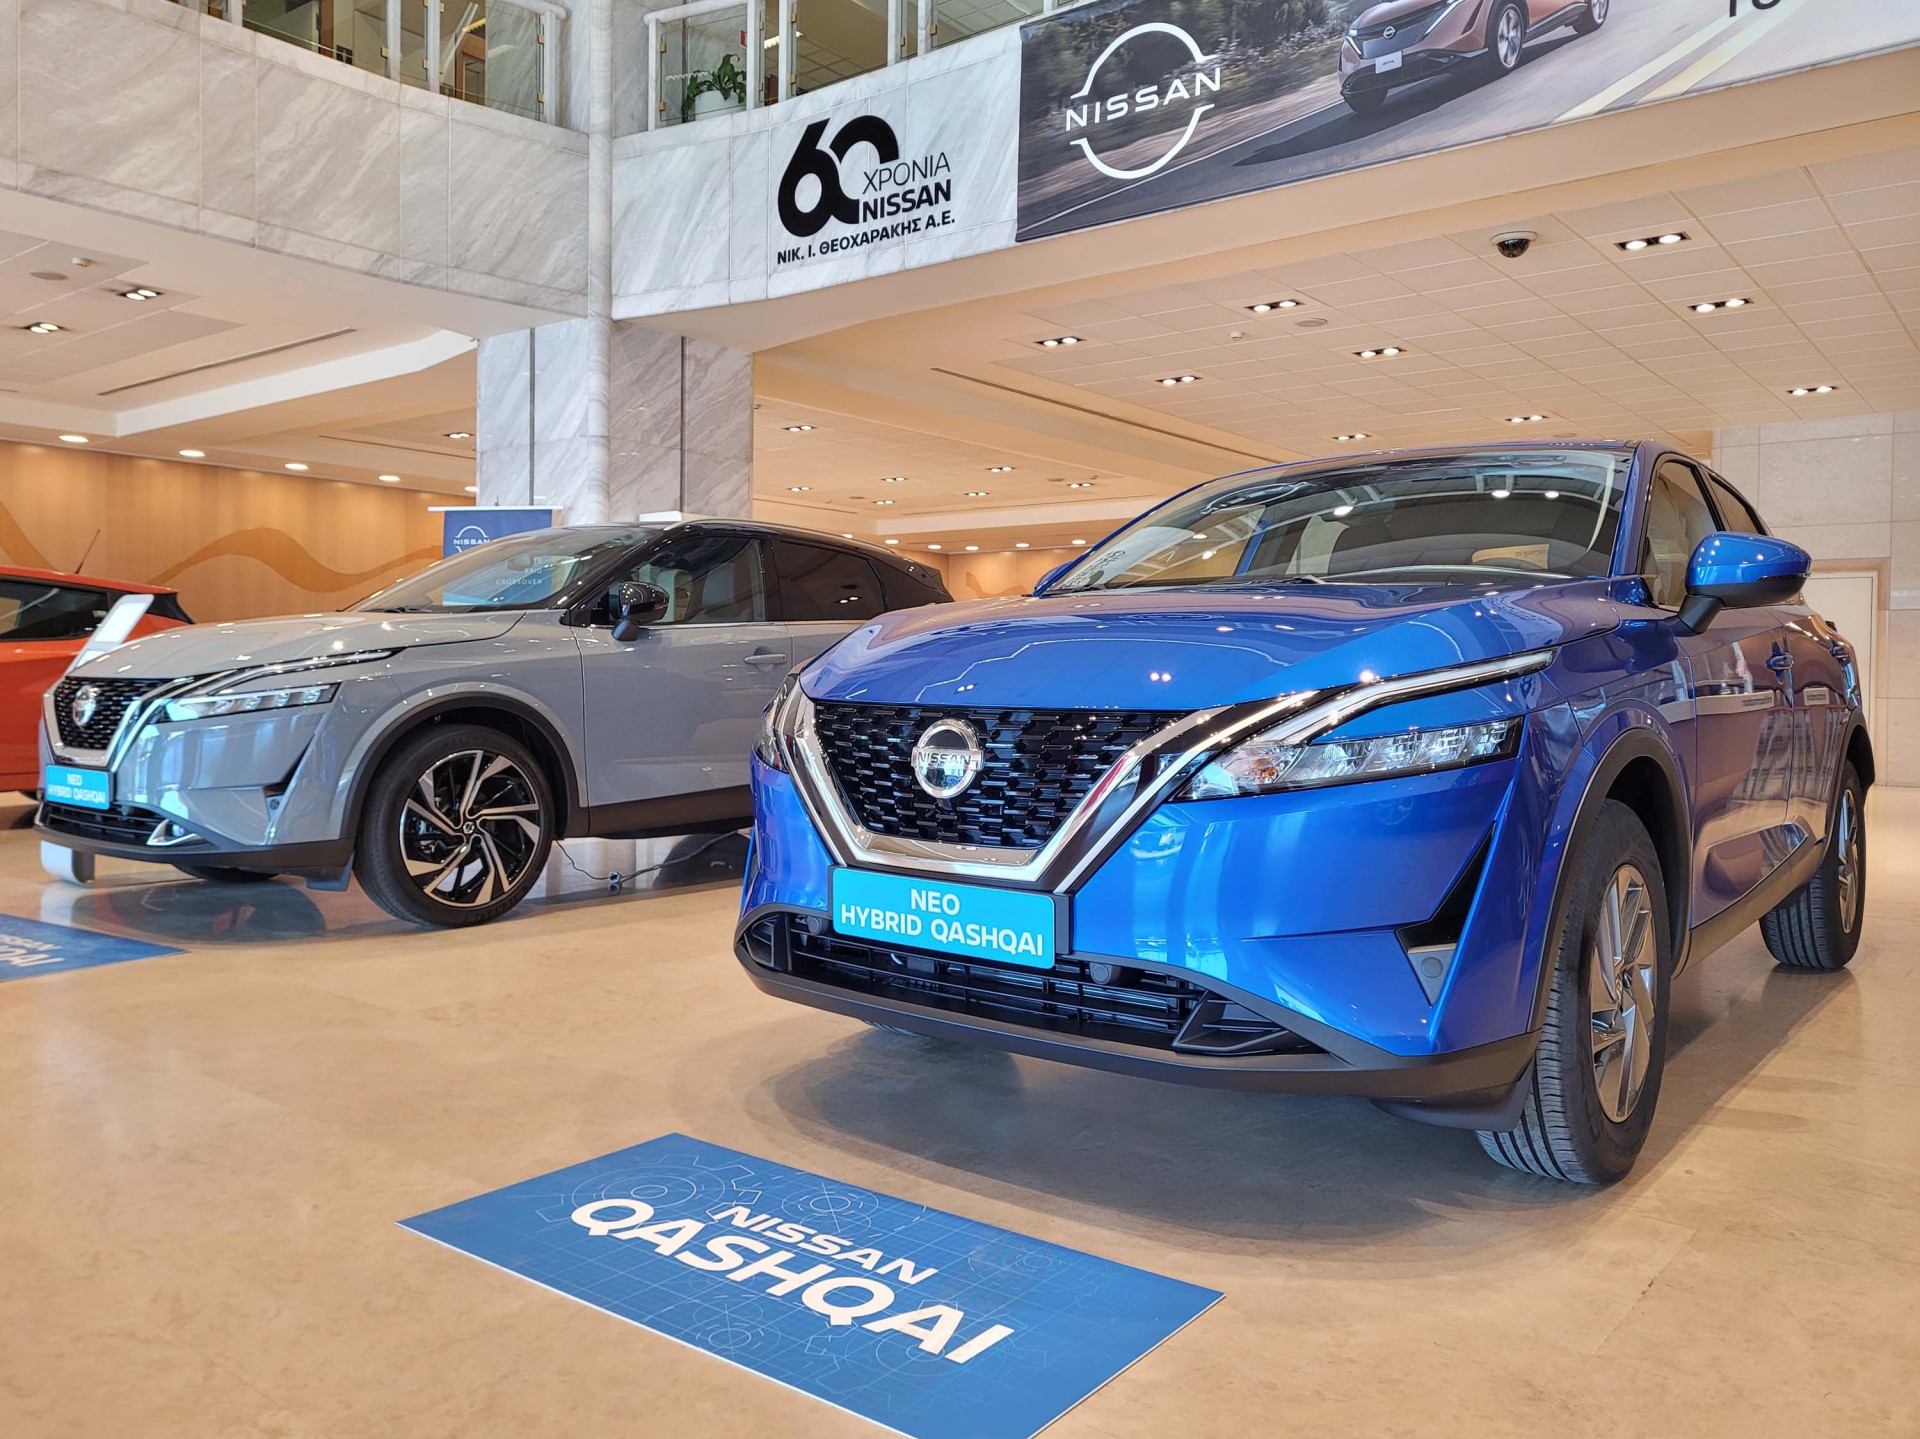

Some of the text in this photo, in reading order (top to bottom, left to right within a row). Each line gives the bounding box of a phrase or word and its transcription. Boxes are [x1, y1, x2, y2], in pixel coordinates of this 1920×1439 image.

[1065, 67, 1221, 131] NISSAN
[777, 115, 899, 237] 60
[862, 152, 951, 194] ΧΡΟΝΙΑ
[862, 179, 951, 222] NISSAN
[777, 210, 956, 265] ΝΙΚ. Ι. ΘΕΟΧΑΡΑΚΗΣ Α.Ε.
[67, 773, 82, 787] NEO
[917, 751, 972, 765] NISSAN
[73, 787, 106, 804] QASHQAI
[910, 888, 960, 916] NEO
[841, 904, 1043, 957] HYBRID QASHQAI
[715, 1205, 939, 1286] NISSAN
[571, 1198, 1015, 1364] QASHQAI
